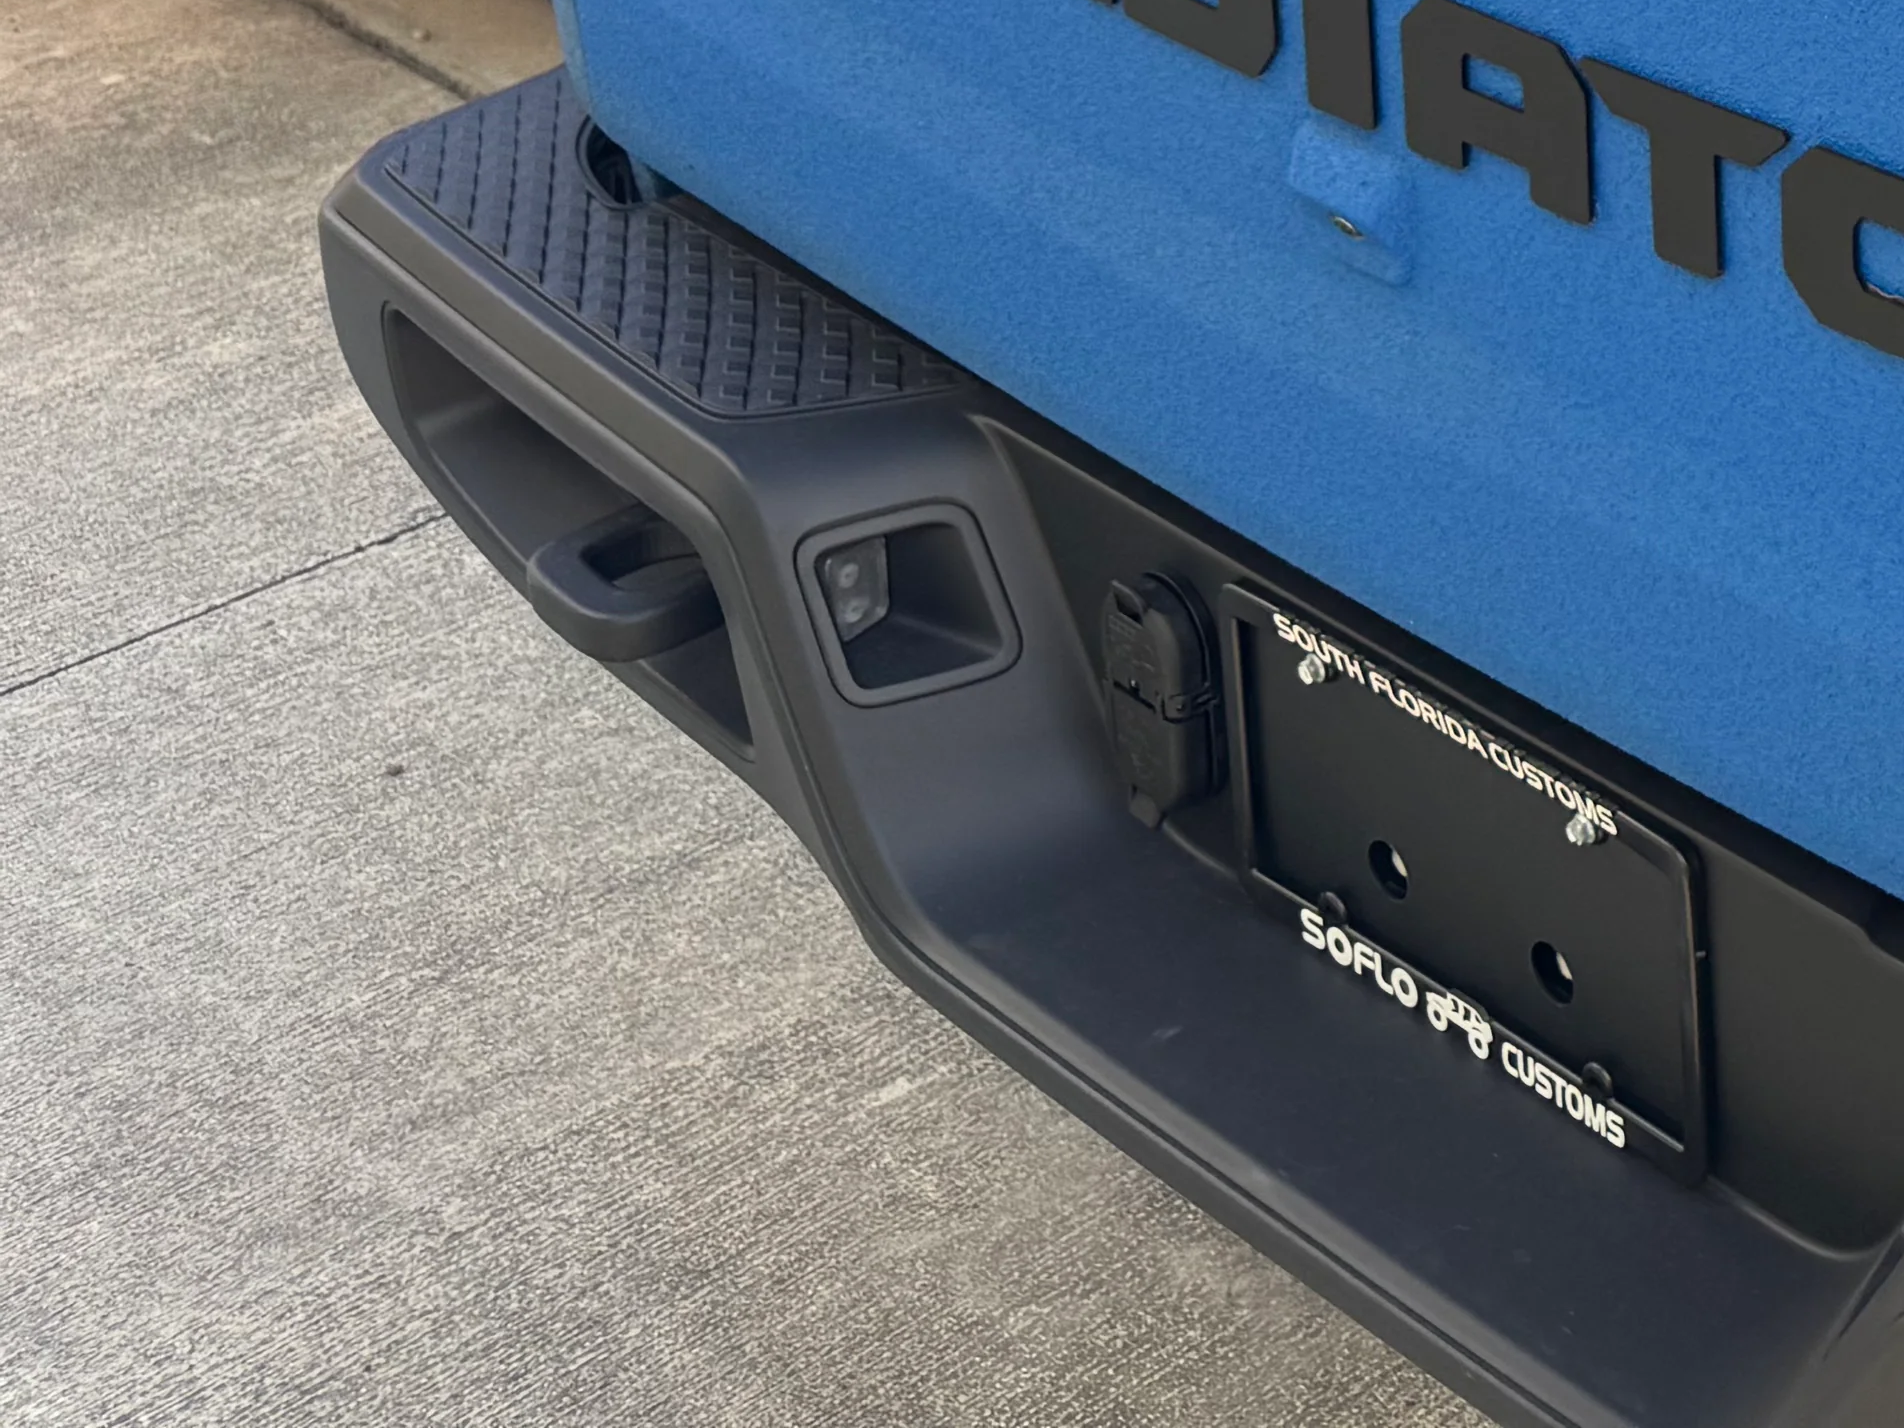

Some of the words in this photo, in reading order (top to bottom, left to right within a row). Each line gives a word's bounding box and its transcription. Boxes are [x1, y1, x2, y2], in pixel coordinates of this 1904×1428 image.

[1273, 612, 1365, 685] SOUTH
[1369, 671, 1488, 758] FLORIDA
[1488, 744, 1618, 836] CUSTOMS
[1300, 908, 1419, 1008] SOFLO
[1501, 1041, 1626, 1148] CUSTOMS
